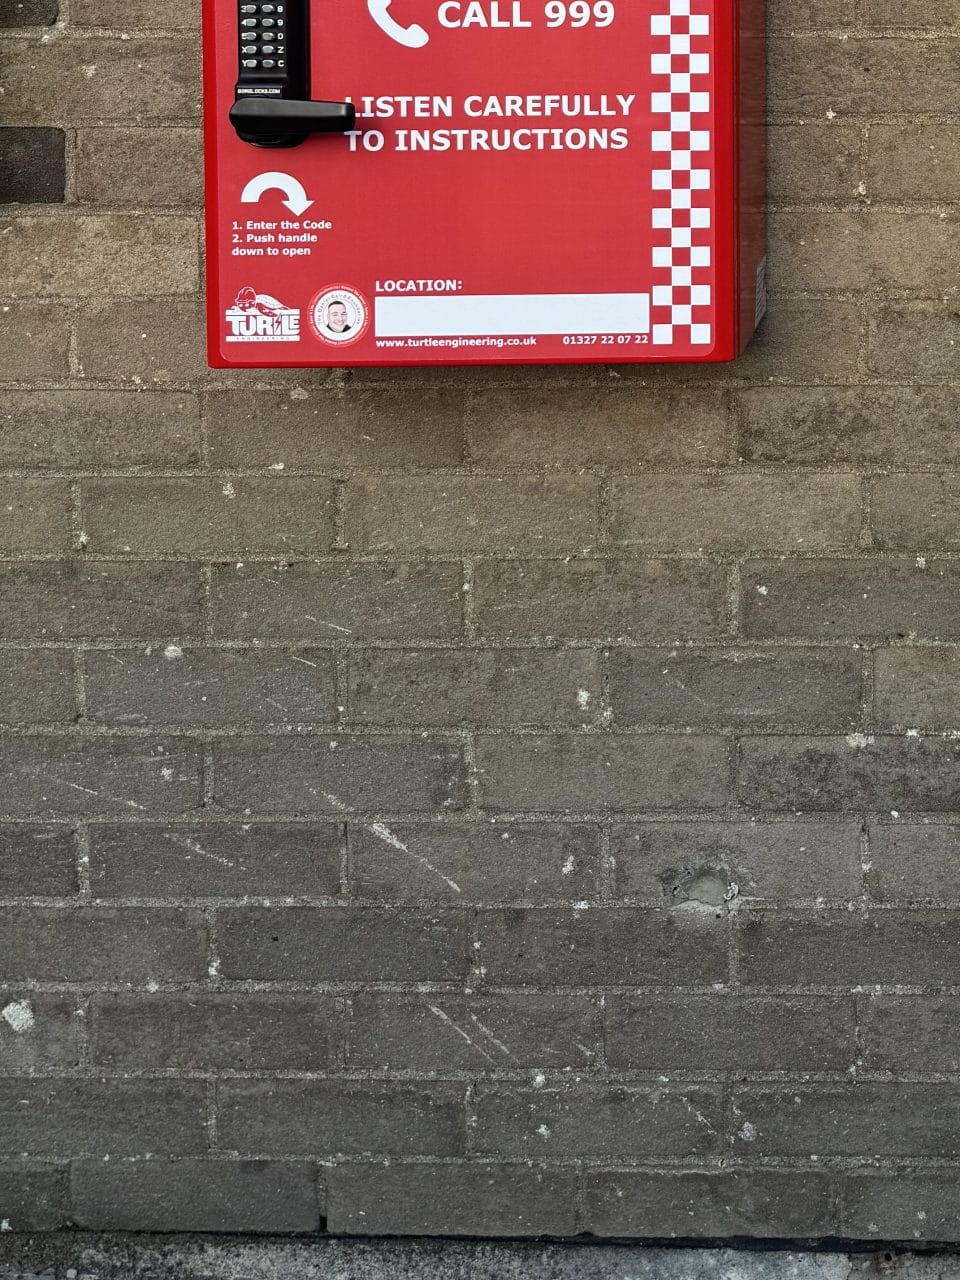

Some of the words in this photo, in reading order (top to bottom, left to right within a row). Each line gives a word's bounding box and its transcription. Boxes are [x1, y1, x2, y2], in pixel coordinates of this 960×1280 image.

[276, 5, 284, 14] 8
[438, 1, 531, 28] CALL
[545, 1, 614, 27] 999
[276, 19, 284, 27] 9
[277, 45, 285, 55] Z
[277, 59, 285, 68] C
[464, 95, 635, 116] CAREFULLY
[343, 129, 385, 152] TO
[396, 128, 628, 150] INSTRUCTIONS
[231, 220, 243, 230] 1.
[246, 220, 278, 230] Enter
[280, 220, 300, 230] the
[303, 220, 332, 230] Code
[231, 233, 243, 243] 2.
[246, 233, 275, 243] Push
[278, 233, 318, 242] handle
[231, 246, 264, 256] down
[266, 247, 279, 256] to
[282, 247, 311, 258] open
[376, 280, 461, 291] LOCATION:
[375, 337, 537, 348] www.turtleengineering.co.uk
[562, 335, 597, 345] 01327
[600, 335, 615, 345] 22
[617, 335, 632, 345] 07
[634, 334, 649, 344] 22
